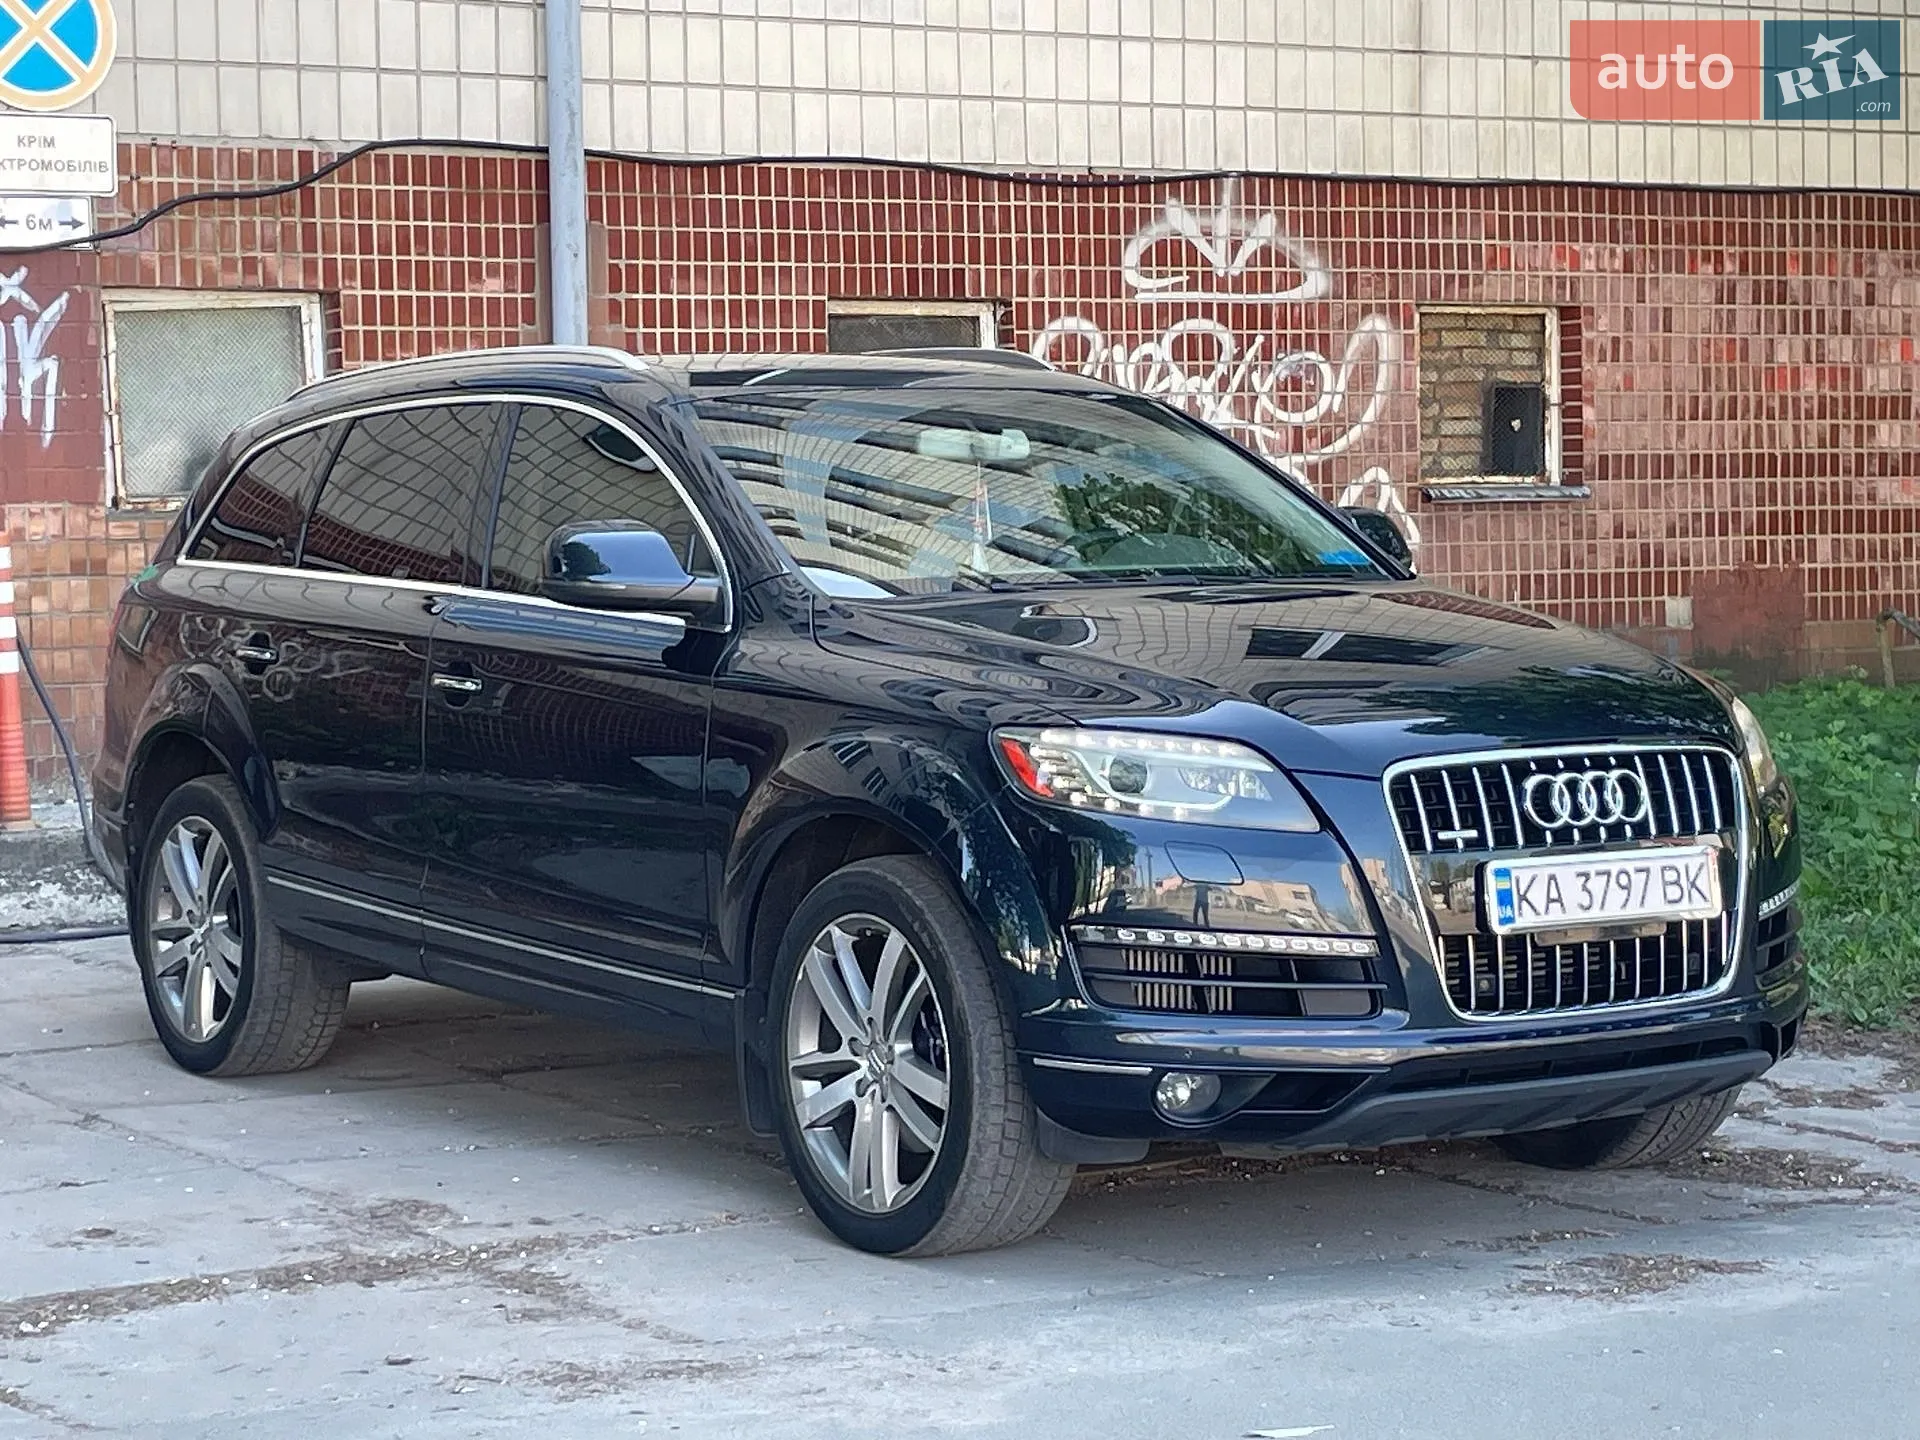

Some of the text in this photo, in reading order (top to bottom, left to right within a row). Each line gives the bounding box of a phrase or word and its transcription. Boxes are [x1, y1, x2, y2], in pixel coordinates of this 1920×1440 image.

[17, 135, 56, 149] КРІМ
[1515, 862, 1710, 917] KA 3797 BK
[1499, 905, 1514, 919] UA
